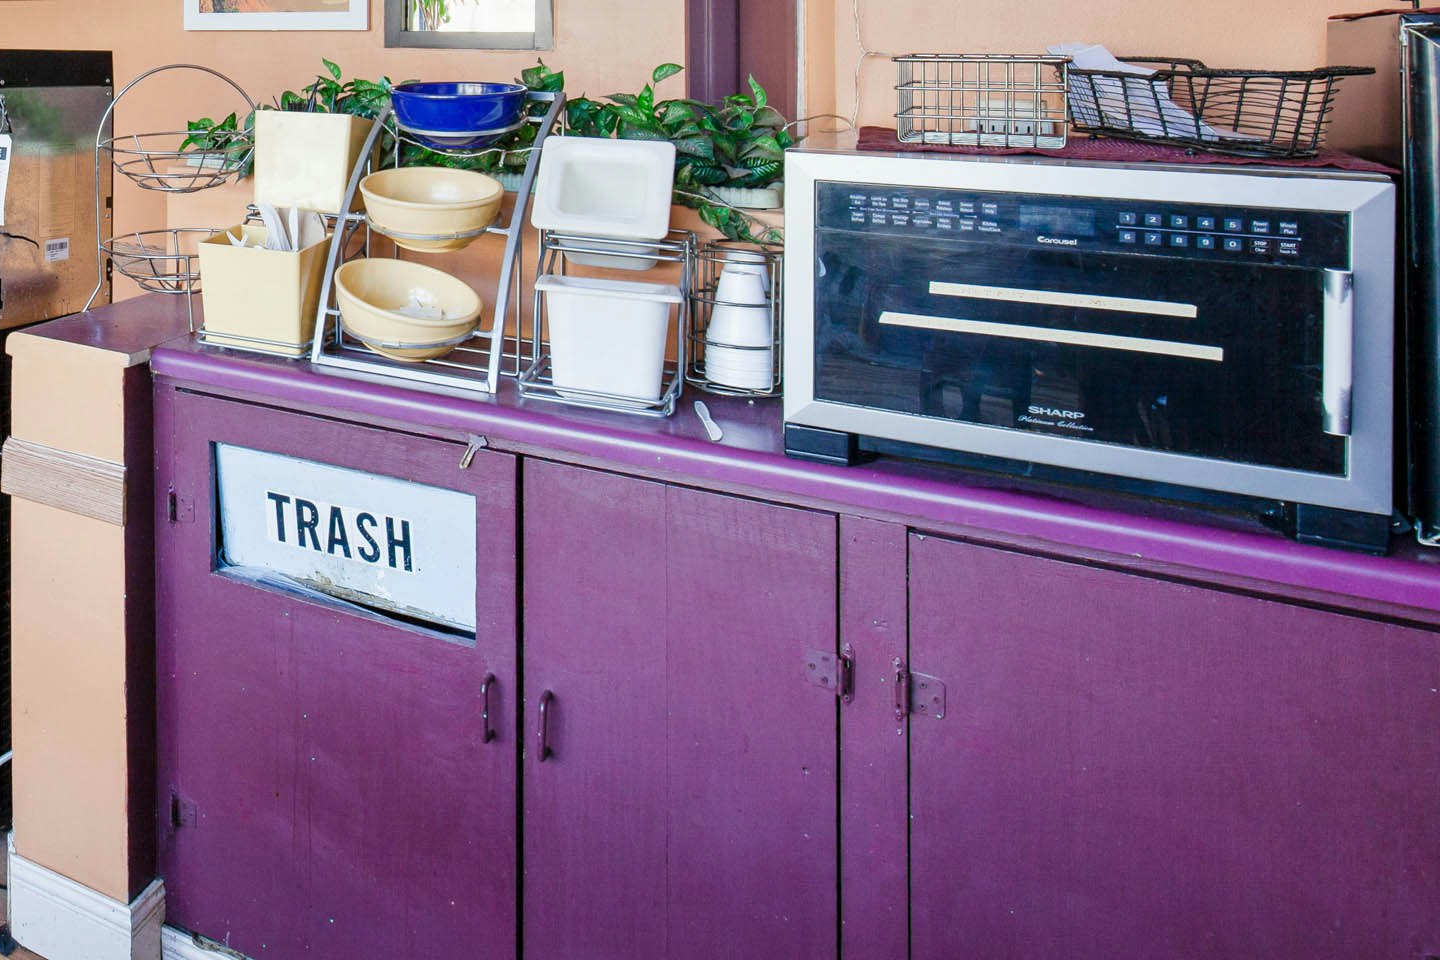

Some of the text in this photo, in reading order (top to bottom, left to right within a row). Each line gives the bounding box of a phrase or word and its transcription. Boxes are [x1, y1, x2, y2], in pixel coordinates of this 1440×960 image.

[1229, 221, 1237, 229] 5
[1036, 235, 1078, 246] Carousel
[1028, 405, 1086, 419] SHARP
[267, 491, 413, 572] TRASH
